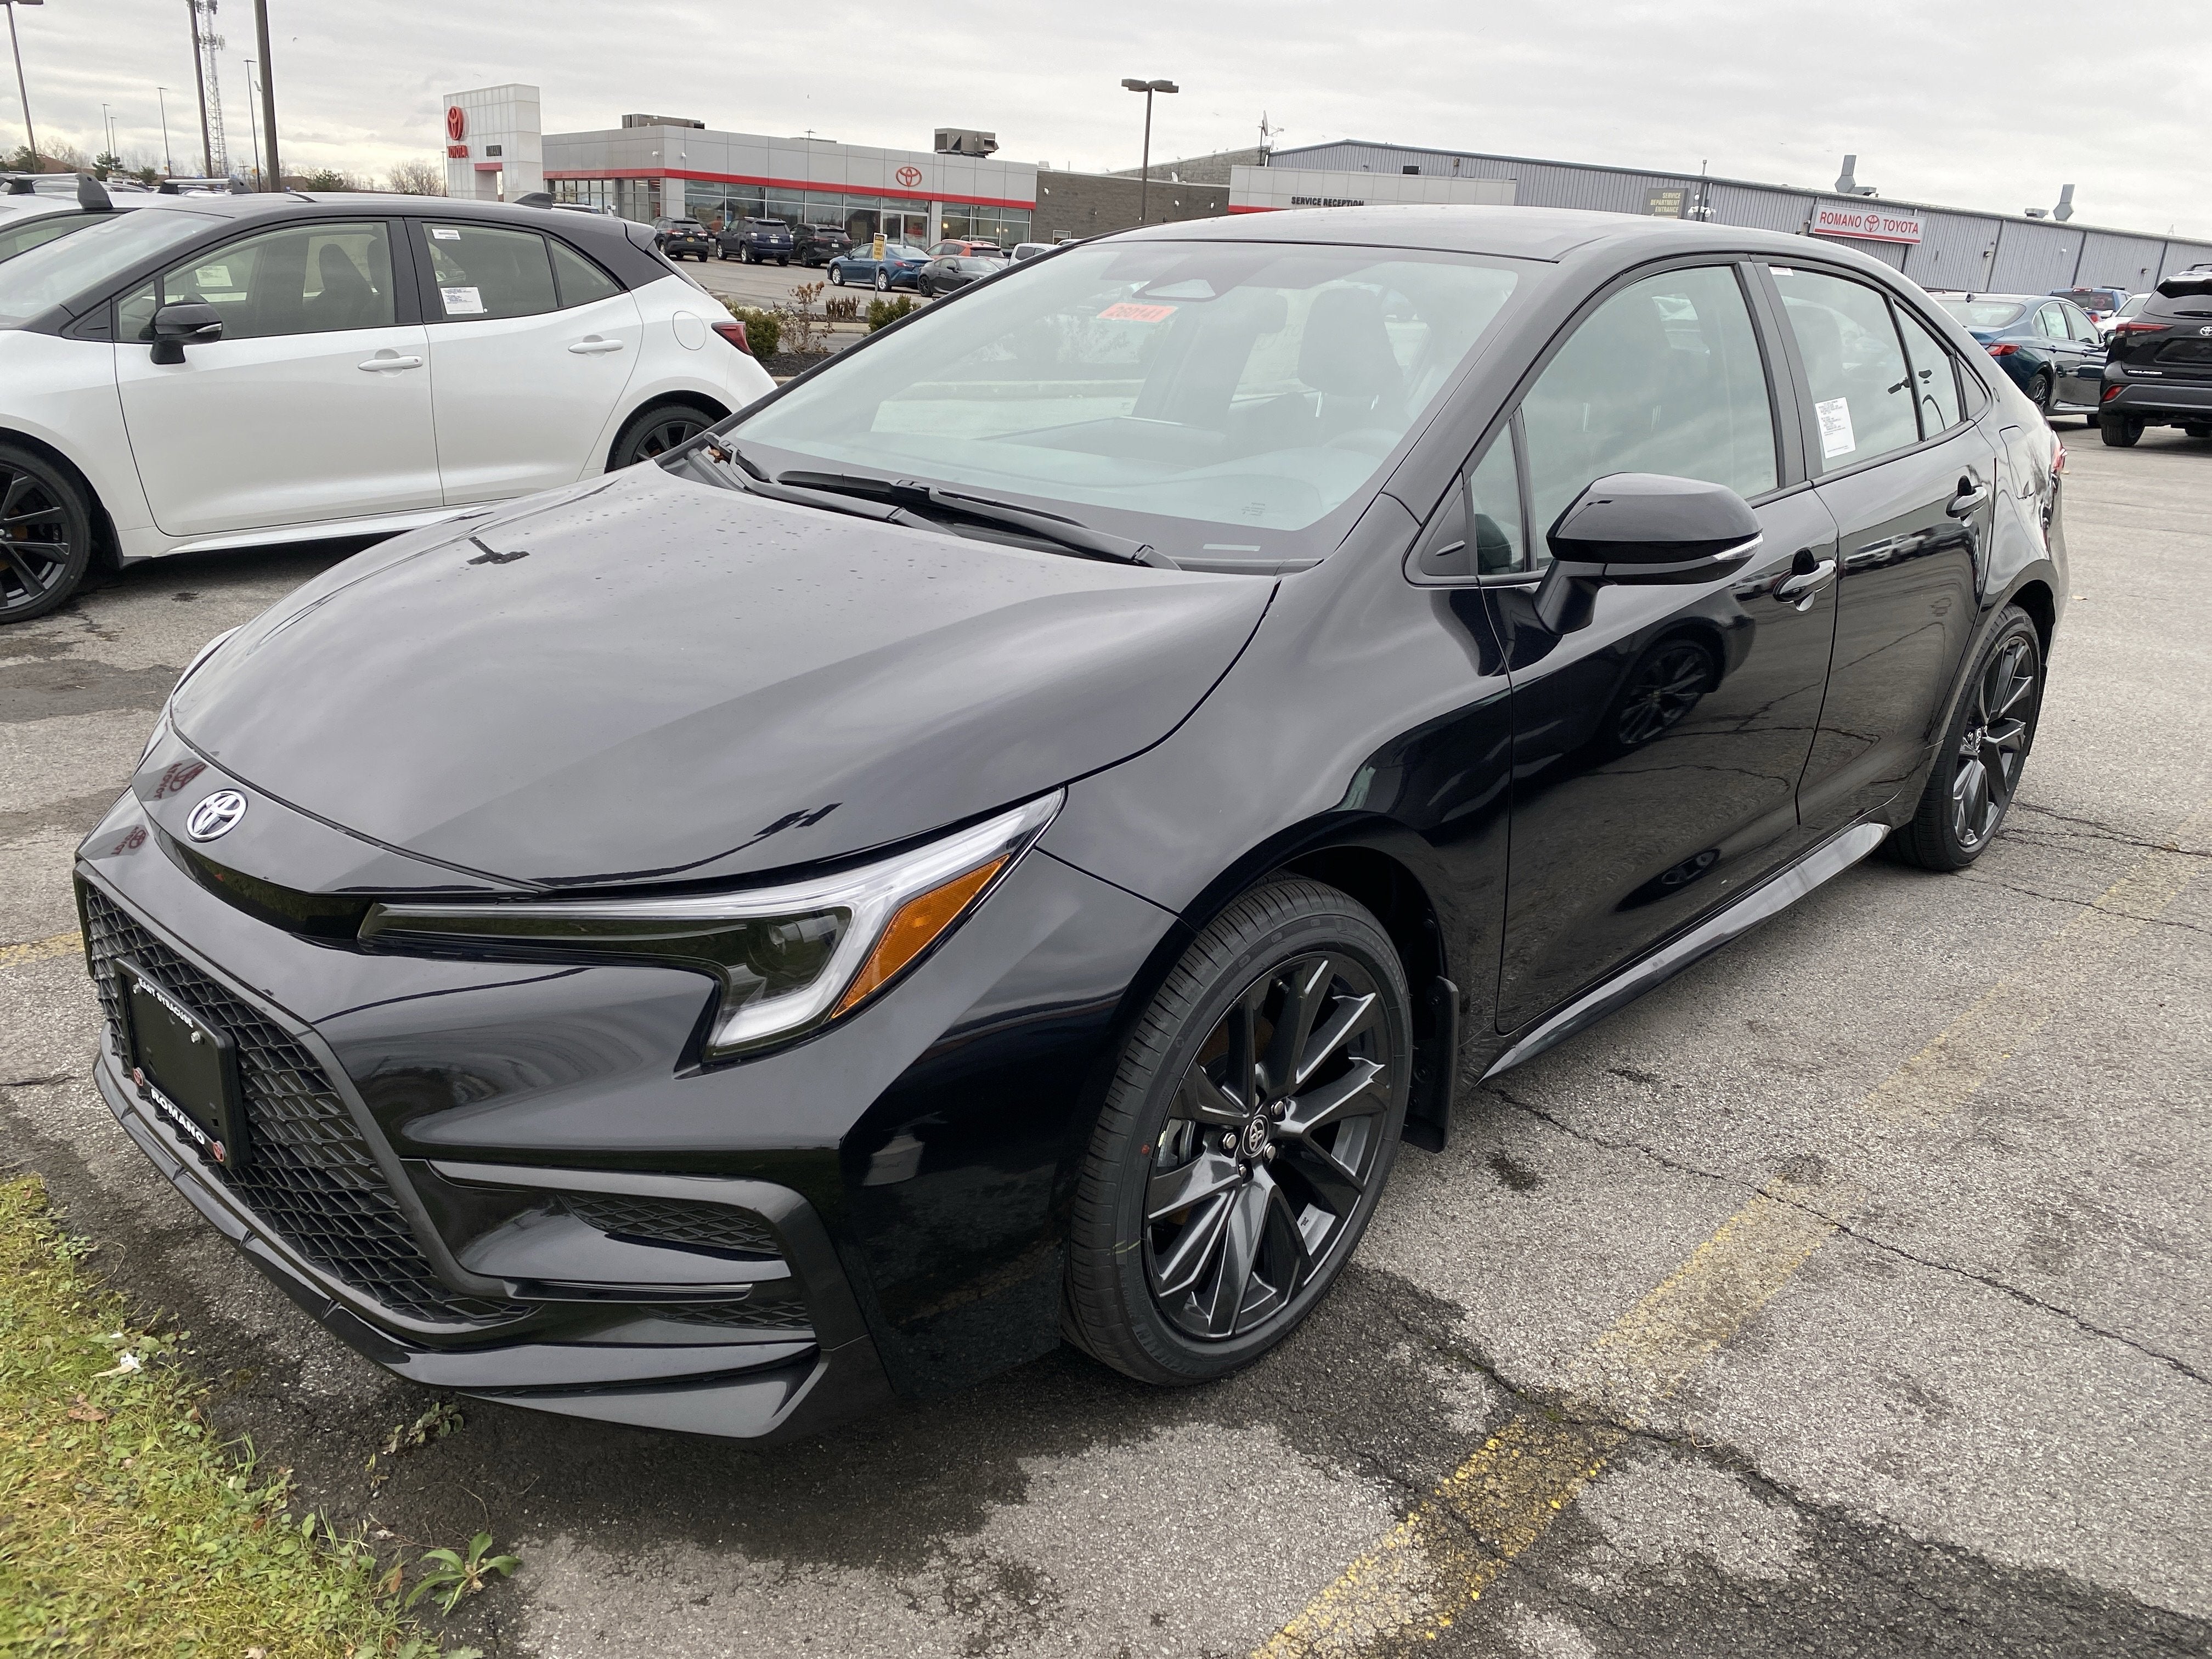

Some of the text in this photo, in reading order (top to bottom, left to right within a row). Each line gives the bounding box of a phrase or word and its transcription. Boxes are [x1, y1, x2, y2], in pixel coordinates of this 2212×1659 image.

[447, 145, 469, 158] TOYOTA
[1291, 196, 1364, 207] SERVICE RECEPTION
[1819, 211, 1918, 234] ROMANO TOYOTA
[138, 977, 194, 1028] EAST SYRACUSE
[151, 1088, 205, 1145] ROMANO
